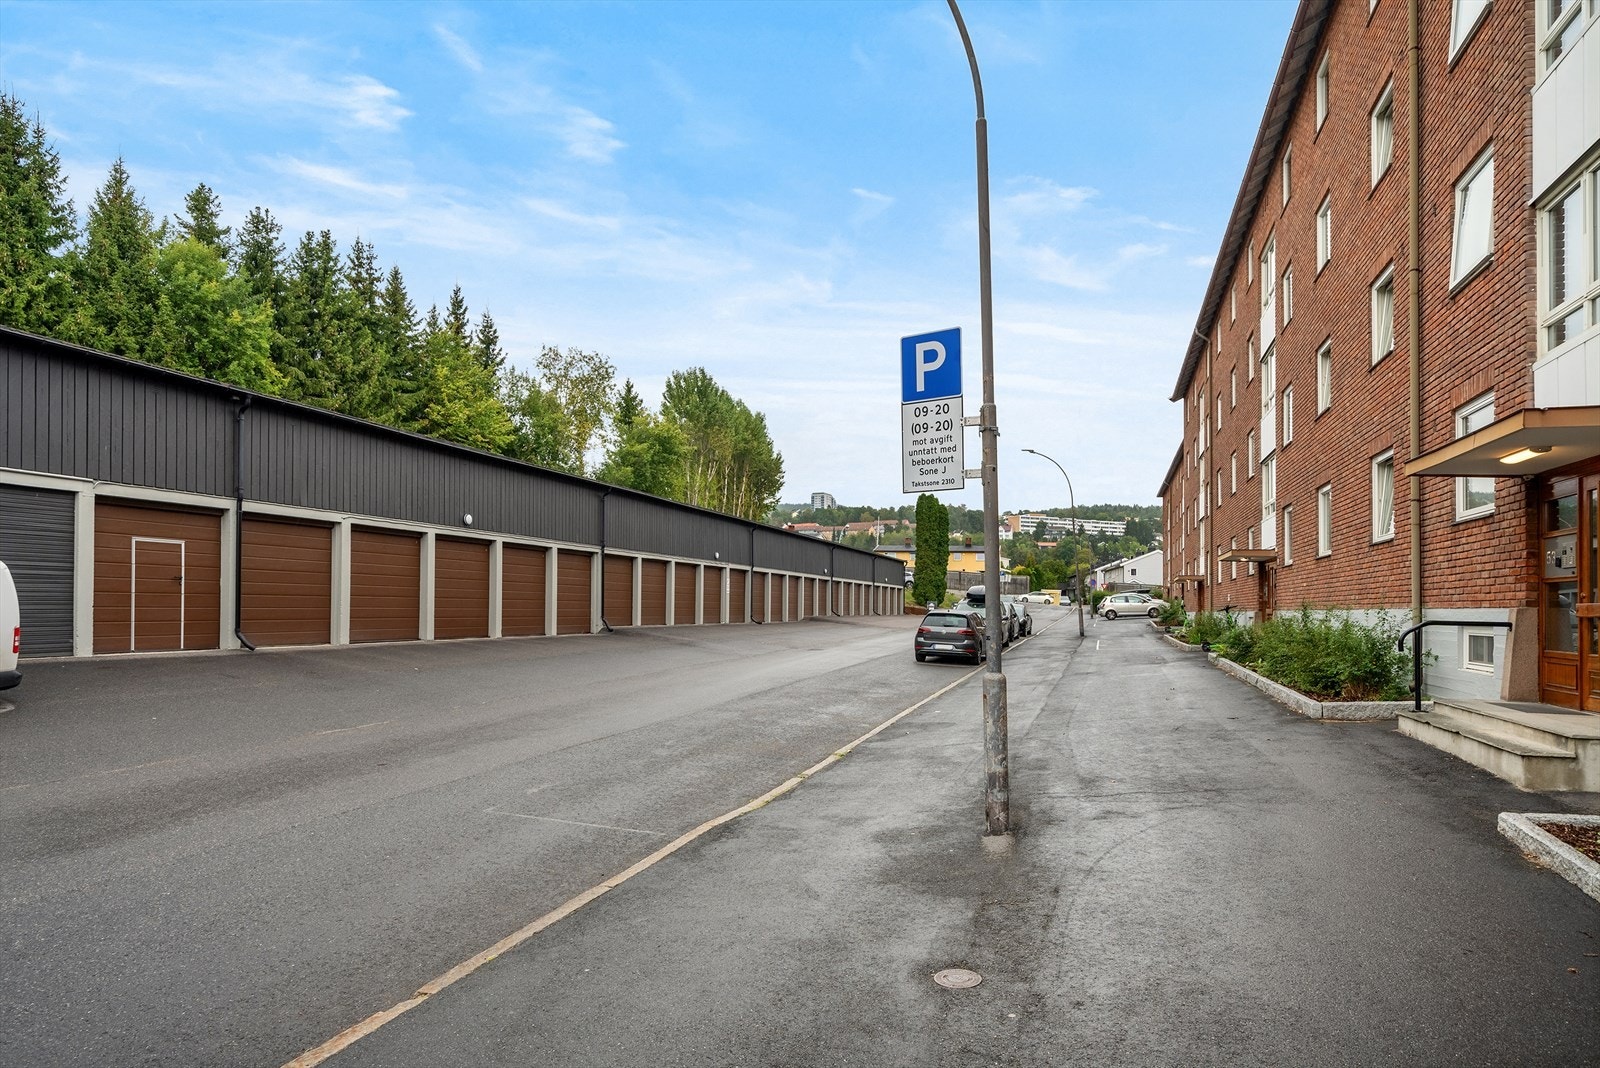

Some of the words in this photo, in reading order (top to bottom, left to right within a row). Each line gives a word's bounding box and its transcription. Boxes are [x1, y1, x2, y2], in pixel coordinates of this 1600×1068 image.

[916, 341, 946, 392] P
[914, 403, 950, 418] 09-20
[911, 418, 953, 435] (09-20)
[912, 438, 927, 446] mot
[929, 435, 953, 445] avgift
[908, 447, 937, 456] unntatt
[940, 444, 957, 453] med
[911, 455, 954, 466] beboerkort
[919, 467, 939, 476] Sone
[941, 466, 946, 474] J
